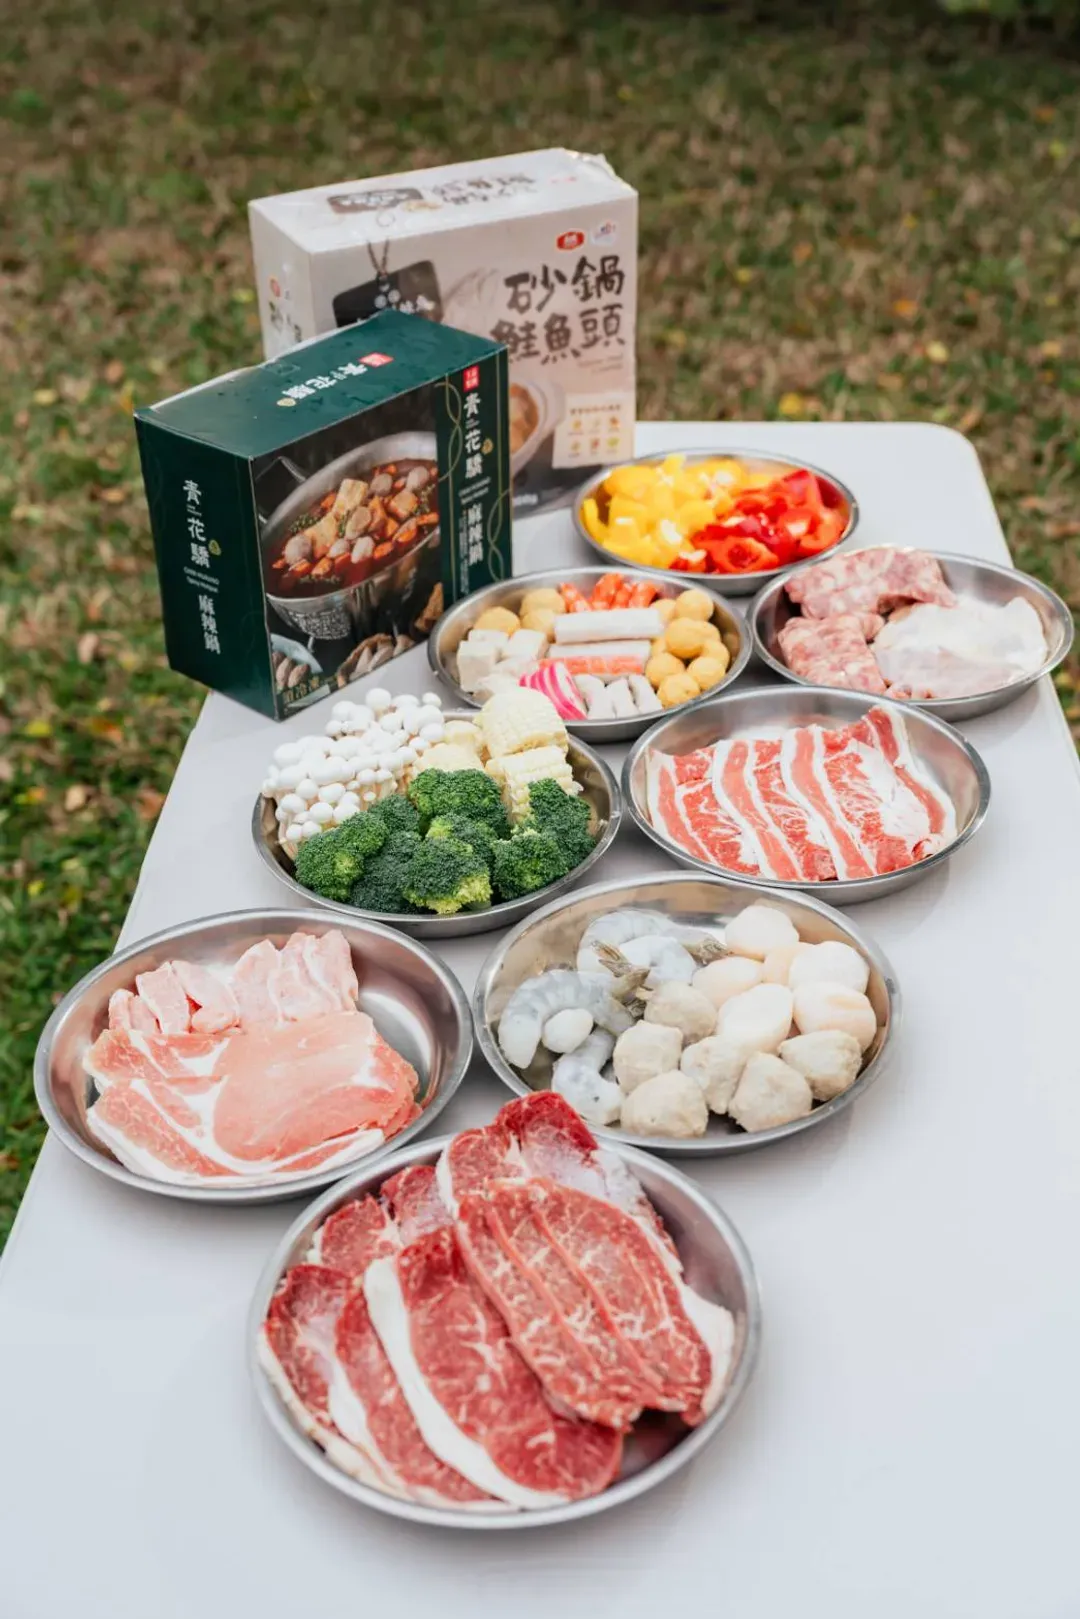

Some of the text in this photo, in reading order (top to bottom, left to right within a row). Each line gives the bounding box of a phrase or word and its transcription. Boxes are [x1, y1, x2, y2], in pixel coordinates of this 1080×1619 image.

[504, 255, 625, 314] 砂鍋
[489, 303, 626, 365] 鮭魚頭
